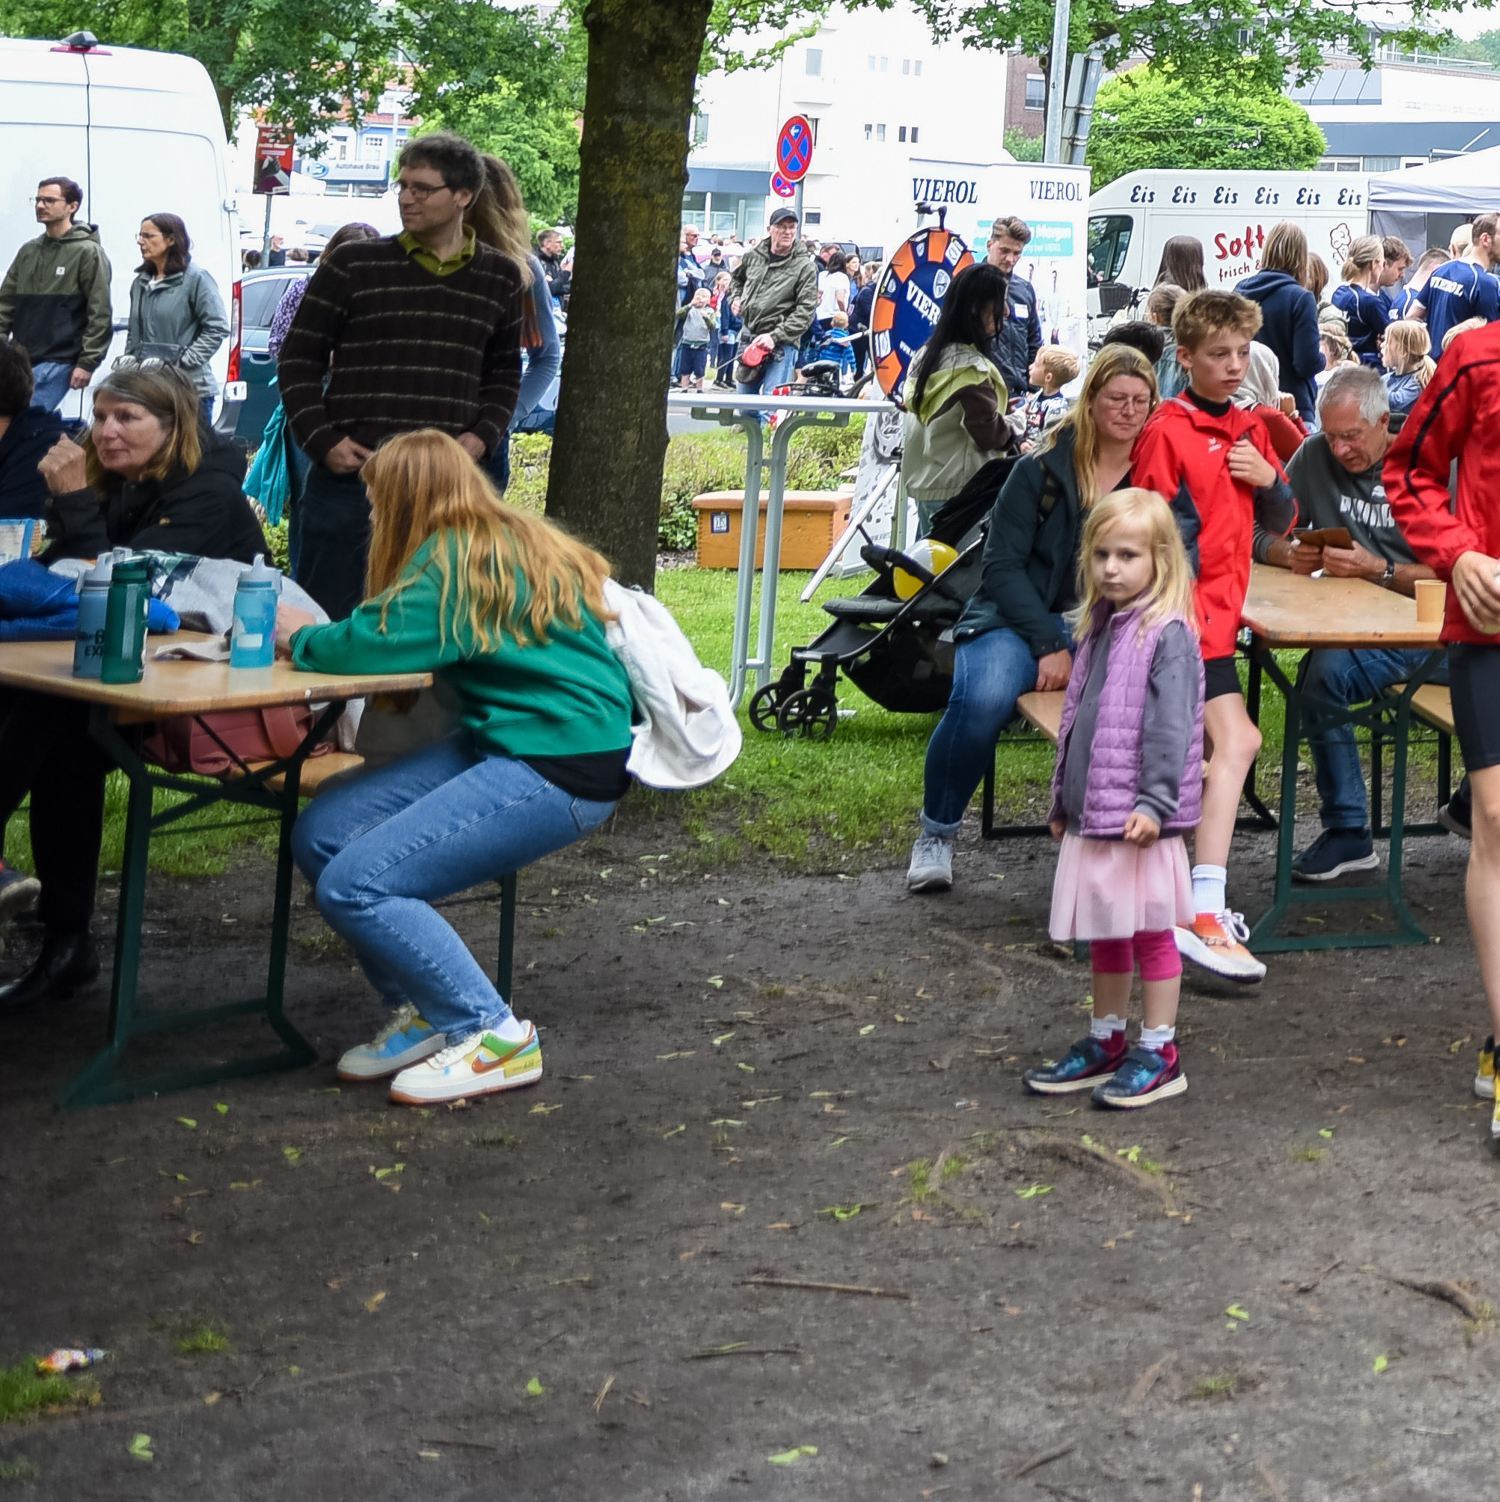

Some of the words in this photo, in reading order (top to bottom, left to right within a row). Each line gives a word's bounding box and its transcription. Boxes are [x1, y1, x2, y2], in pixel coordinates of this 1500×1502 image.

[912, 177, 978, 204] VIEROL
[1030, 180, 1083, 202] VIEROL
[1130, 185, 1155, 203] Eis
[1172, 185, 1197, 204] Eis
[1213, 186, 1239, 204] Eis
[1255, 186, 1280, 205] Eis
[1296, 187, 1321, 205] Eis
[1337, 188, 1362, 206] Eis
[1218, 261, 1251, 282] frisch
[905, 279, 942, 327] VIER
